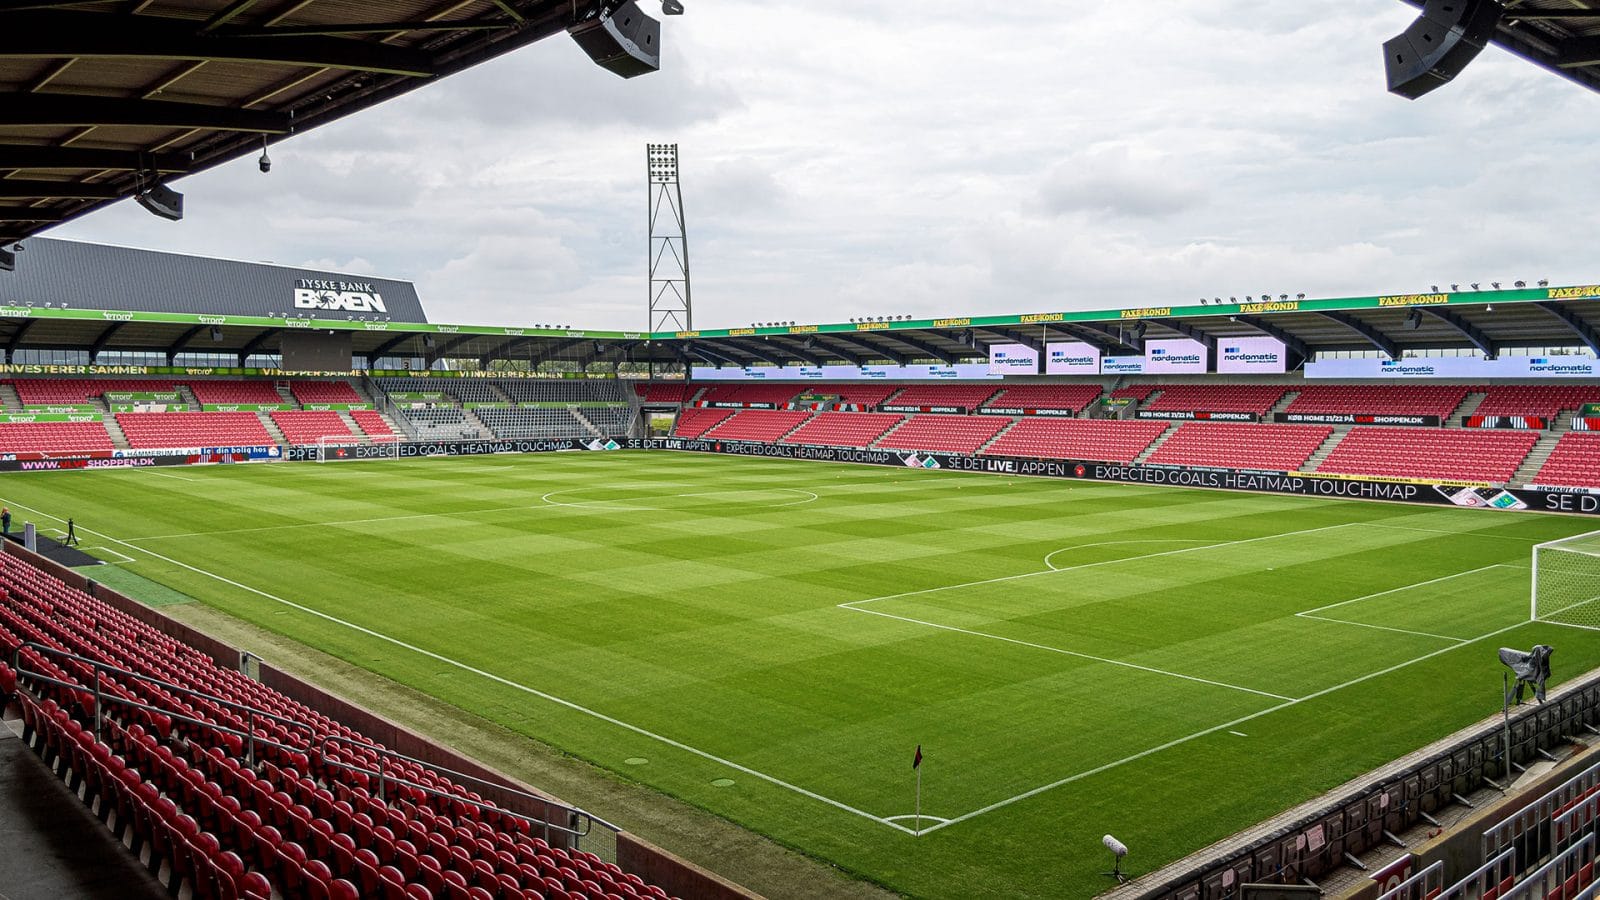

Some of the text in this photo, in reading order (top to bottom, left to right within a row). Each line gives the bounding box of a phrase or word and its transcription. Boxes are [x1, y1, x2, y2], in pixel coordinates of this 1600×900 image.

[301, 278, 373, 293] JYSKE BANK
[1379, 294, 1449, 306] FAXE KONDI
[1240, 301, 1299, 312] FAXE KONDI
[1121, 307, 1171, 318] FAXE KONDI
[1225, 353, 1278, 361] nordomatic
[0, 365, 148, 375] INVESTERER SAMMEN
[403, 361, 409, 370] 3
[262, 368, 274, 376] VI
[1344, 414, 1355, 422] PÅ
[516, 440, 572, 452] TOUCHMAP
[628, 440, 641, 448] SE
[644, 440, 663, 448] DET
[666, 439, 681, 449] LIVE
[726, 444, 764, 456] EXPECTED
[837, 451, 889, 463] TOUCHMAP
[949, 457, 961, 469] SE
[964, 458, 986, 470] DET
[987, 461, 1013, 472] LIVE
[1020, 462, 1065, 476] APP'EN
[1095, 465, 1165, 483] EXPECTED
[1169, 471, 1221, 488] GOALS,
[1225, 476, 1306, 495] HEATMAP,
[1310, 479, 1417, 500] TOUCHMAP
[1546, 493, 1573, 511] SE
